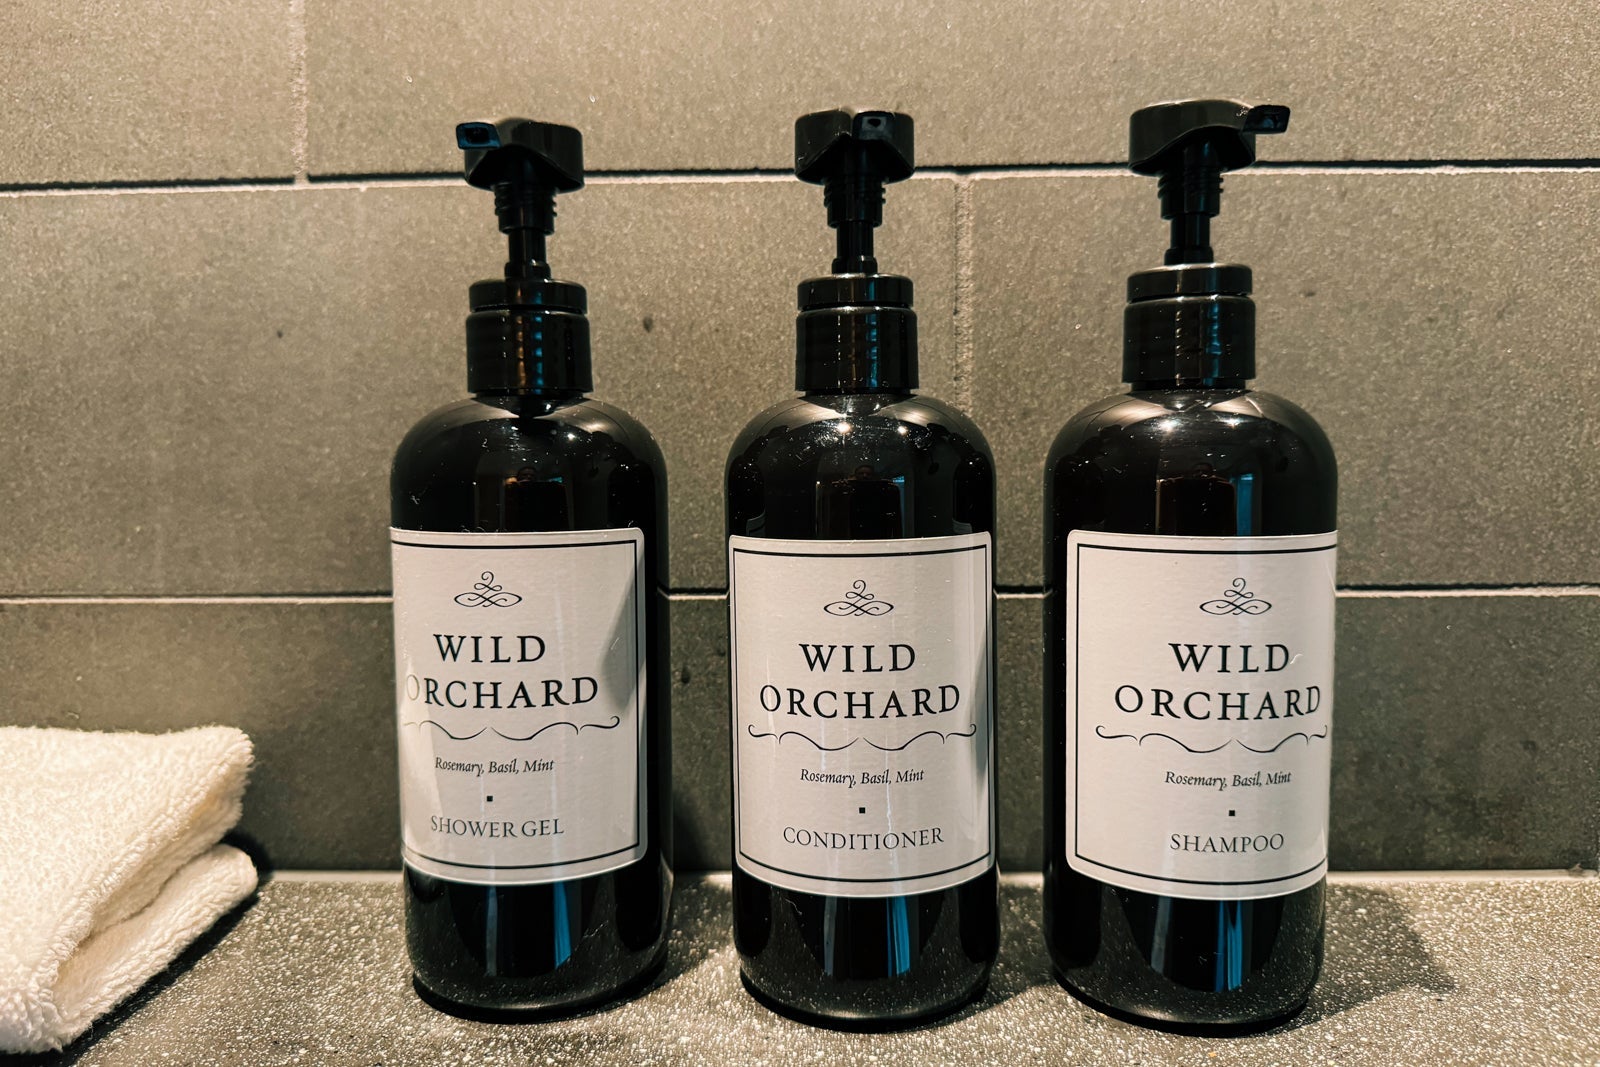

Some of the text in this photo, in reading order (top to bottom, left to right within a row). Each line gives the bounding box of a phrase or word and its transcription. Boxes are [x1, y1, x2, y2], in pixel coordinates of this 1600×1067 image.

[433, 634, 546, 663] WILD
[798, 643, 916, 673] WILD
[1168, 642, 1290, 673] WILD
[405, 674, 599, 709] ORCHARD
[759, 684, 960, 719] ORCHARD
[1114, 684, 1321, 721] ORCHARD
[434, 757, 554, 777] Rosemary, Basil, Mint
[800, 769, 925, 789] Rosemary, Basil, Mint
[1165, 770, 1292, 791] Rosemary, Basil, Mint
[430, 815, 565, 838] SHOWER GEL
[783, 826, 944, 850] CONDITIONER
[1169, 833, 1285, 853] SHAMPOO
